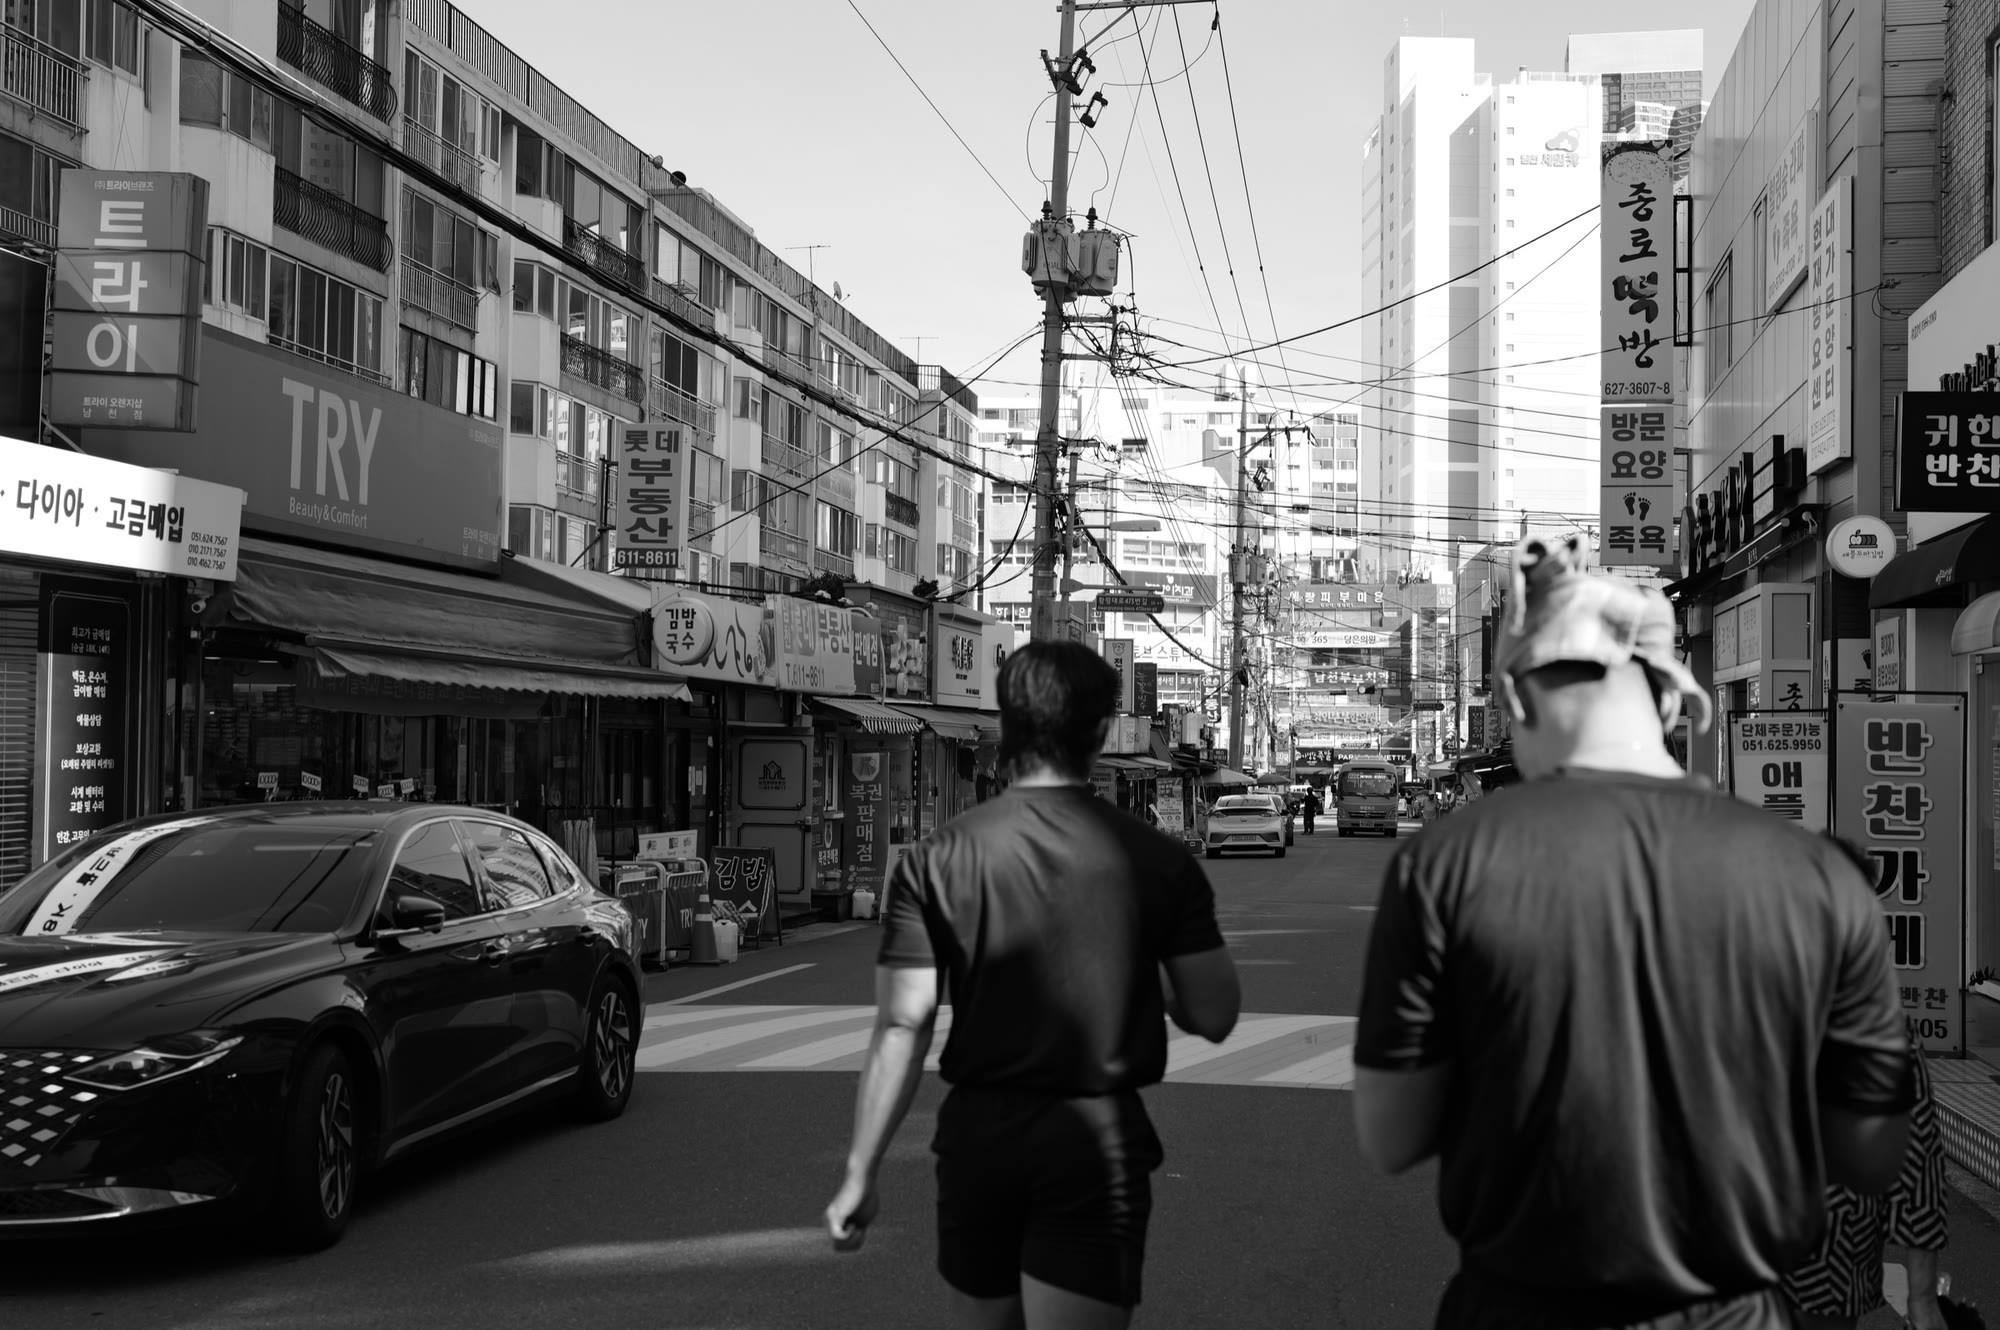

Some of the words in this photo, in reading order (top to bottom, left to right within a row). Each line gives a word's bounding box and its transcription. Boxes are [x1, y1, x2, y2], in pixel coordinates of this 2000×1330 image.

[86, 200, 147, 372] 트라이
[1612, 182, 1659, 368] 종로떡방
[1604, 382, 1670, 395] 627-3607~8
[282, 378, 382, 505] TRY
[624, 430, 679, 453] 롯데
[1611, 412, 1665, 442] 방문
[1611, 450, 1666, 480] 요양
[17, 479, 84, 527] 다이아
[106, 496, 185, 543] 고금매입
[624, 458, 673, 544] 부동산
[1608, 525, 1666, 554] 족욕
[617, 550, 676, 565] 611-8611
[665, 608, 696, 630] 김밥
[818, 608, 850, 654] 부동산
[666, 632, 695, 654] 국수
[785, 663, 825, 688] T.611-8611
[1741, 722, 1821, 737] 단체주문가능
[1742, 739, 1822, 751] 051.625.9950
[849, 783, 882, 802] 복권
[856, 803, 876, 863] 판매점
[713, 856, 767, 891] 김밥
